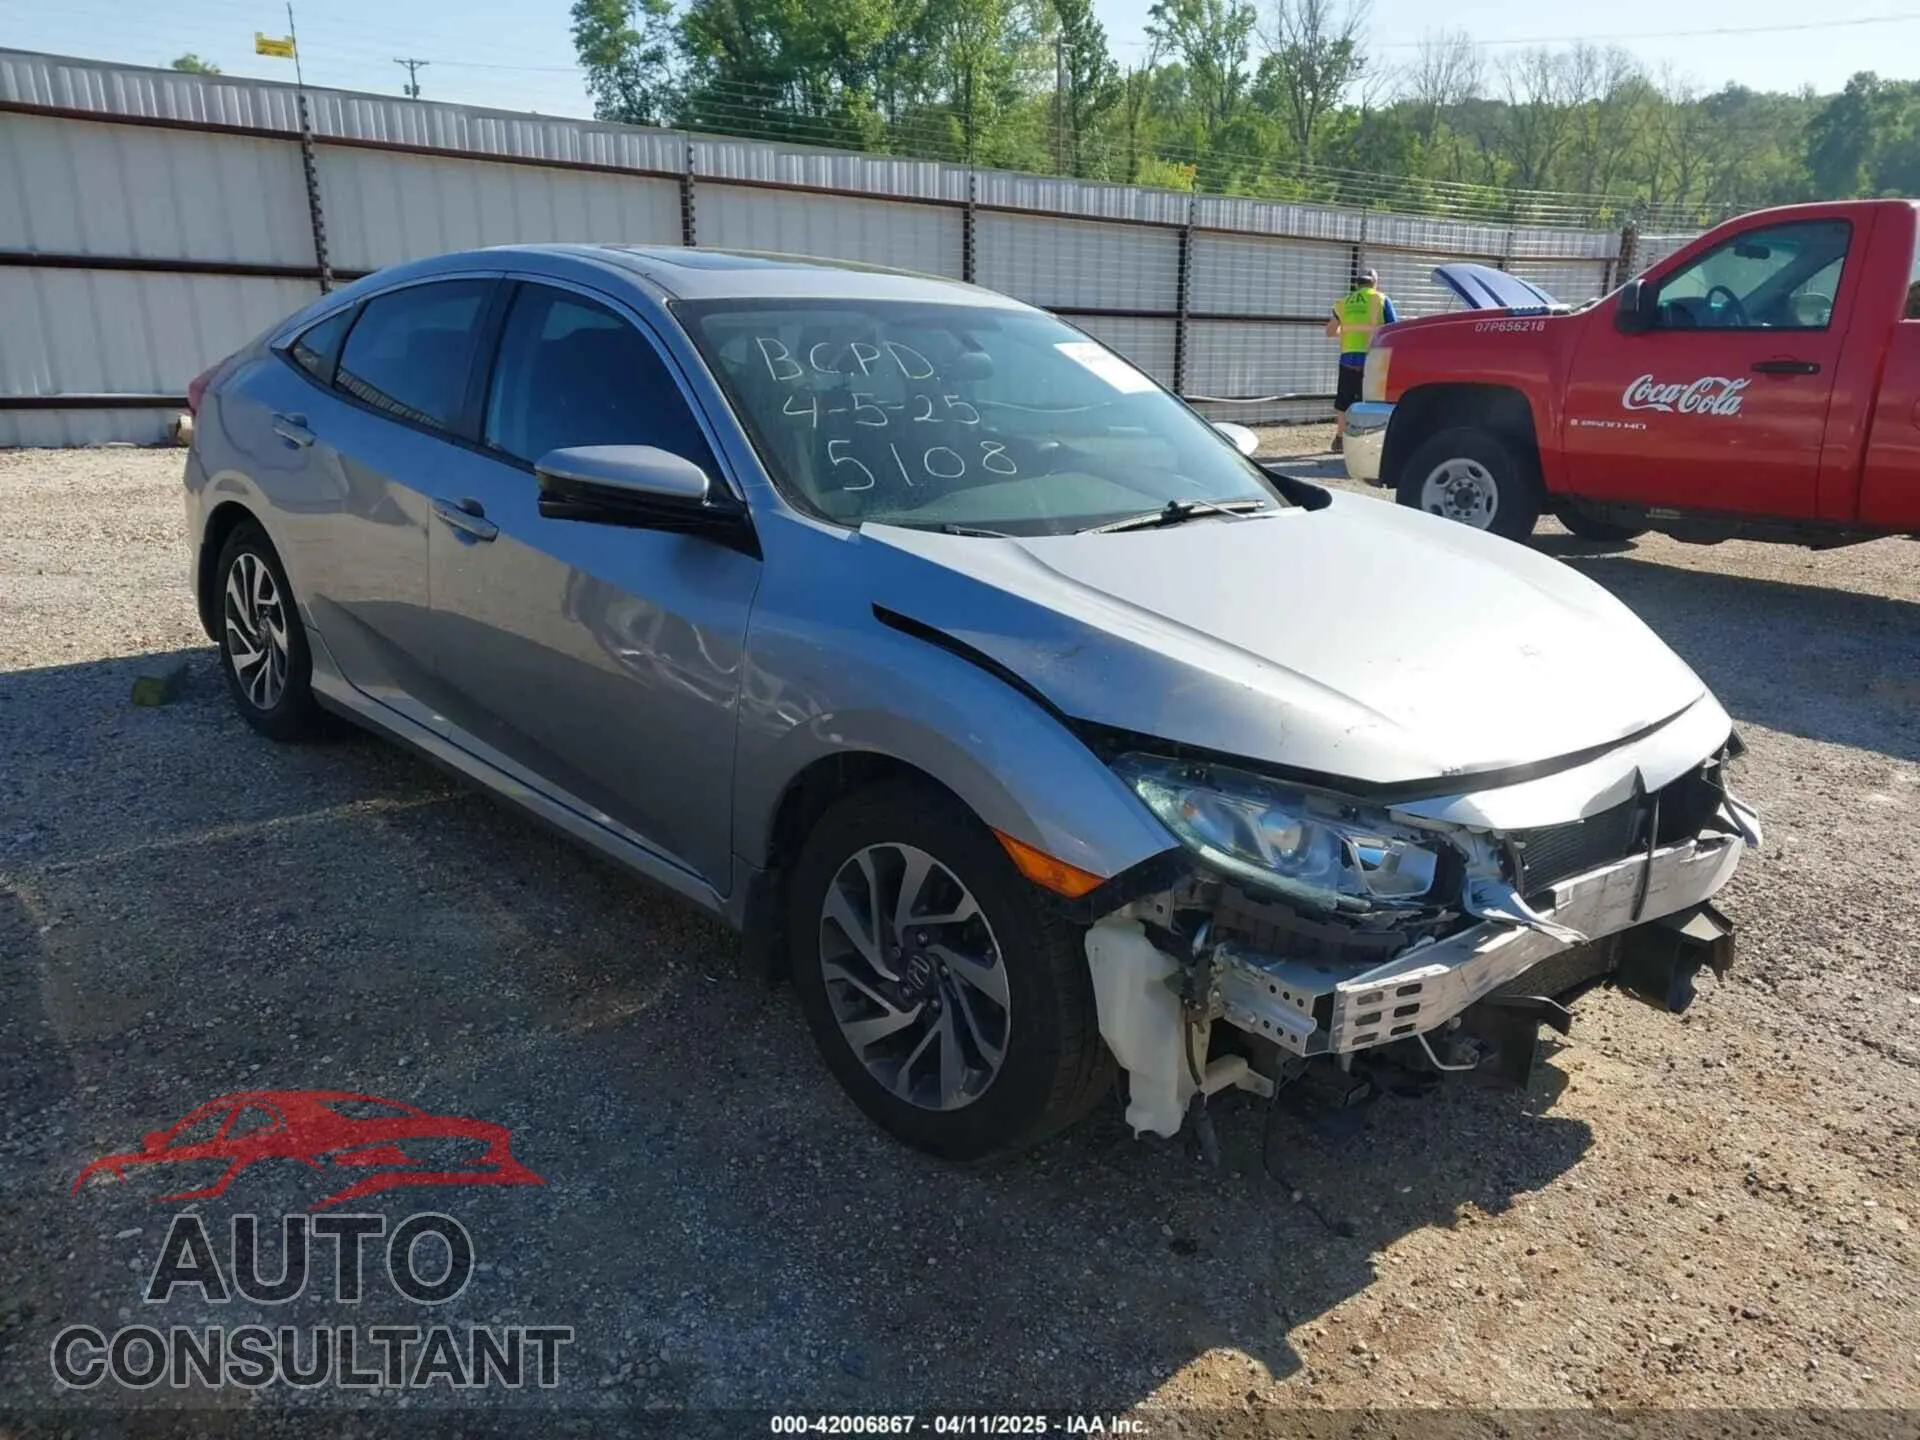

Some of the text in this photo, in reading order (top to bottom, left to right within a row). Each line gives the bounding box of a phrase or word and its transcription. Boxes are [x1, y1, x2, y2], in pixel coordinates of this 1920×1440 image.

[783, 393, 981, 428] 4-5-25
[1622, 374, 1752, 415] Coca-Cola
[828, 440, 1017, 490] 5108
